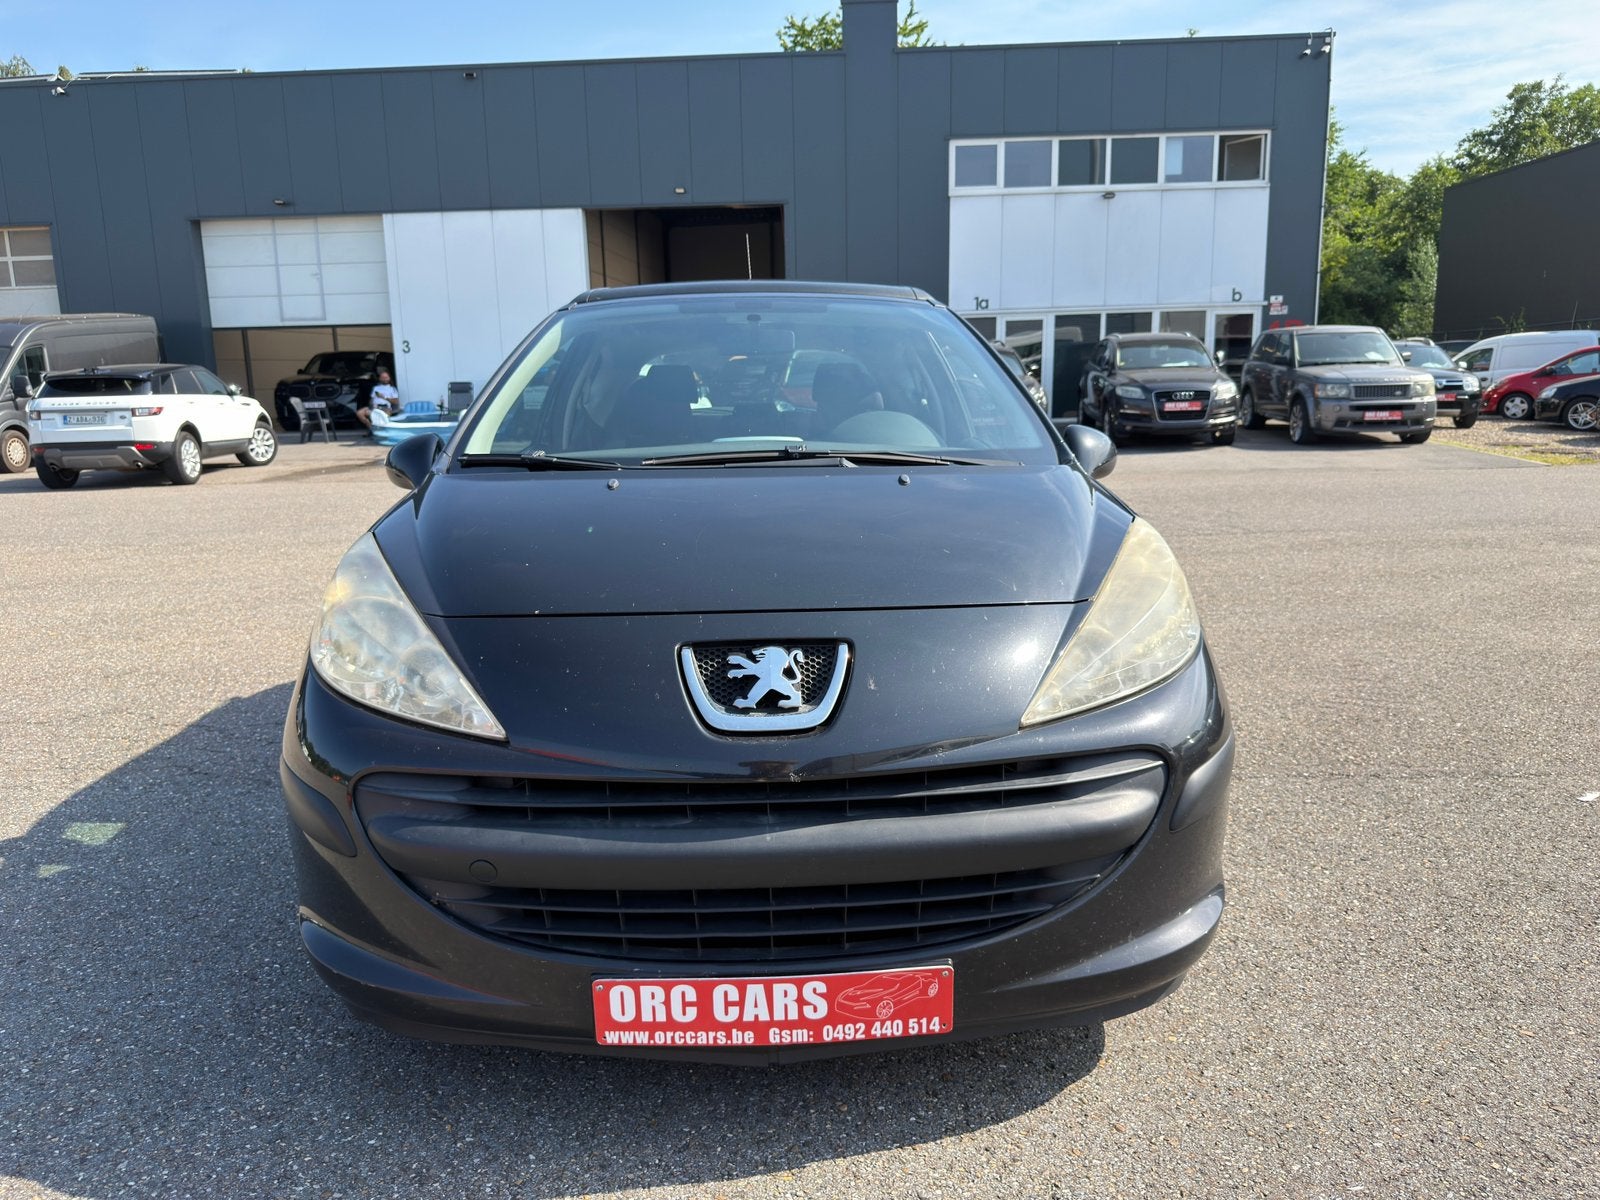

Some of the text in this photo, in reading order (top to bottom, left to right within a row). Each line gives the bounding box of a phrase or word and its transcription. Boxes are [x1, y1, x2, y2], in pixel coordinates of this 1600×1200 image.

[1232, 288, 1242, 302] b
[974, 296, 989, 311] 1a
[402, 340, 411, 353] 3
[609, 980, 828, 1023] ORC CARS
[604, 1016, 940, 1044] www.orccars.be Gsm: 0492 440 514
